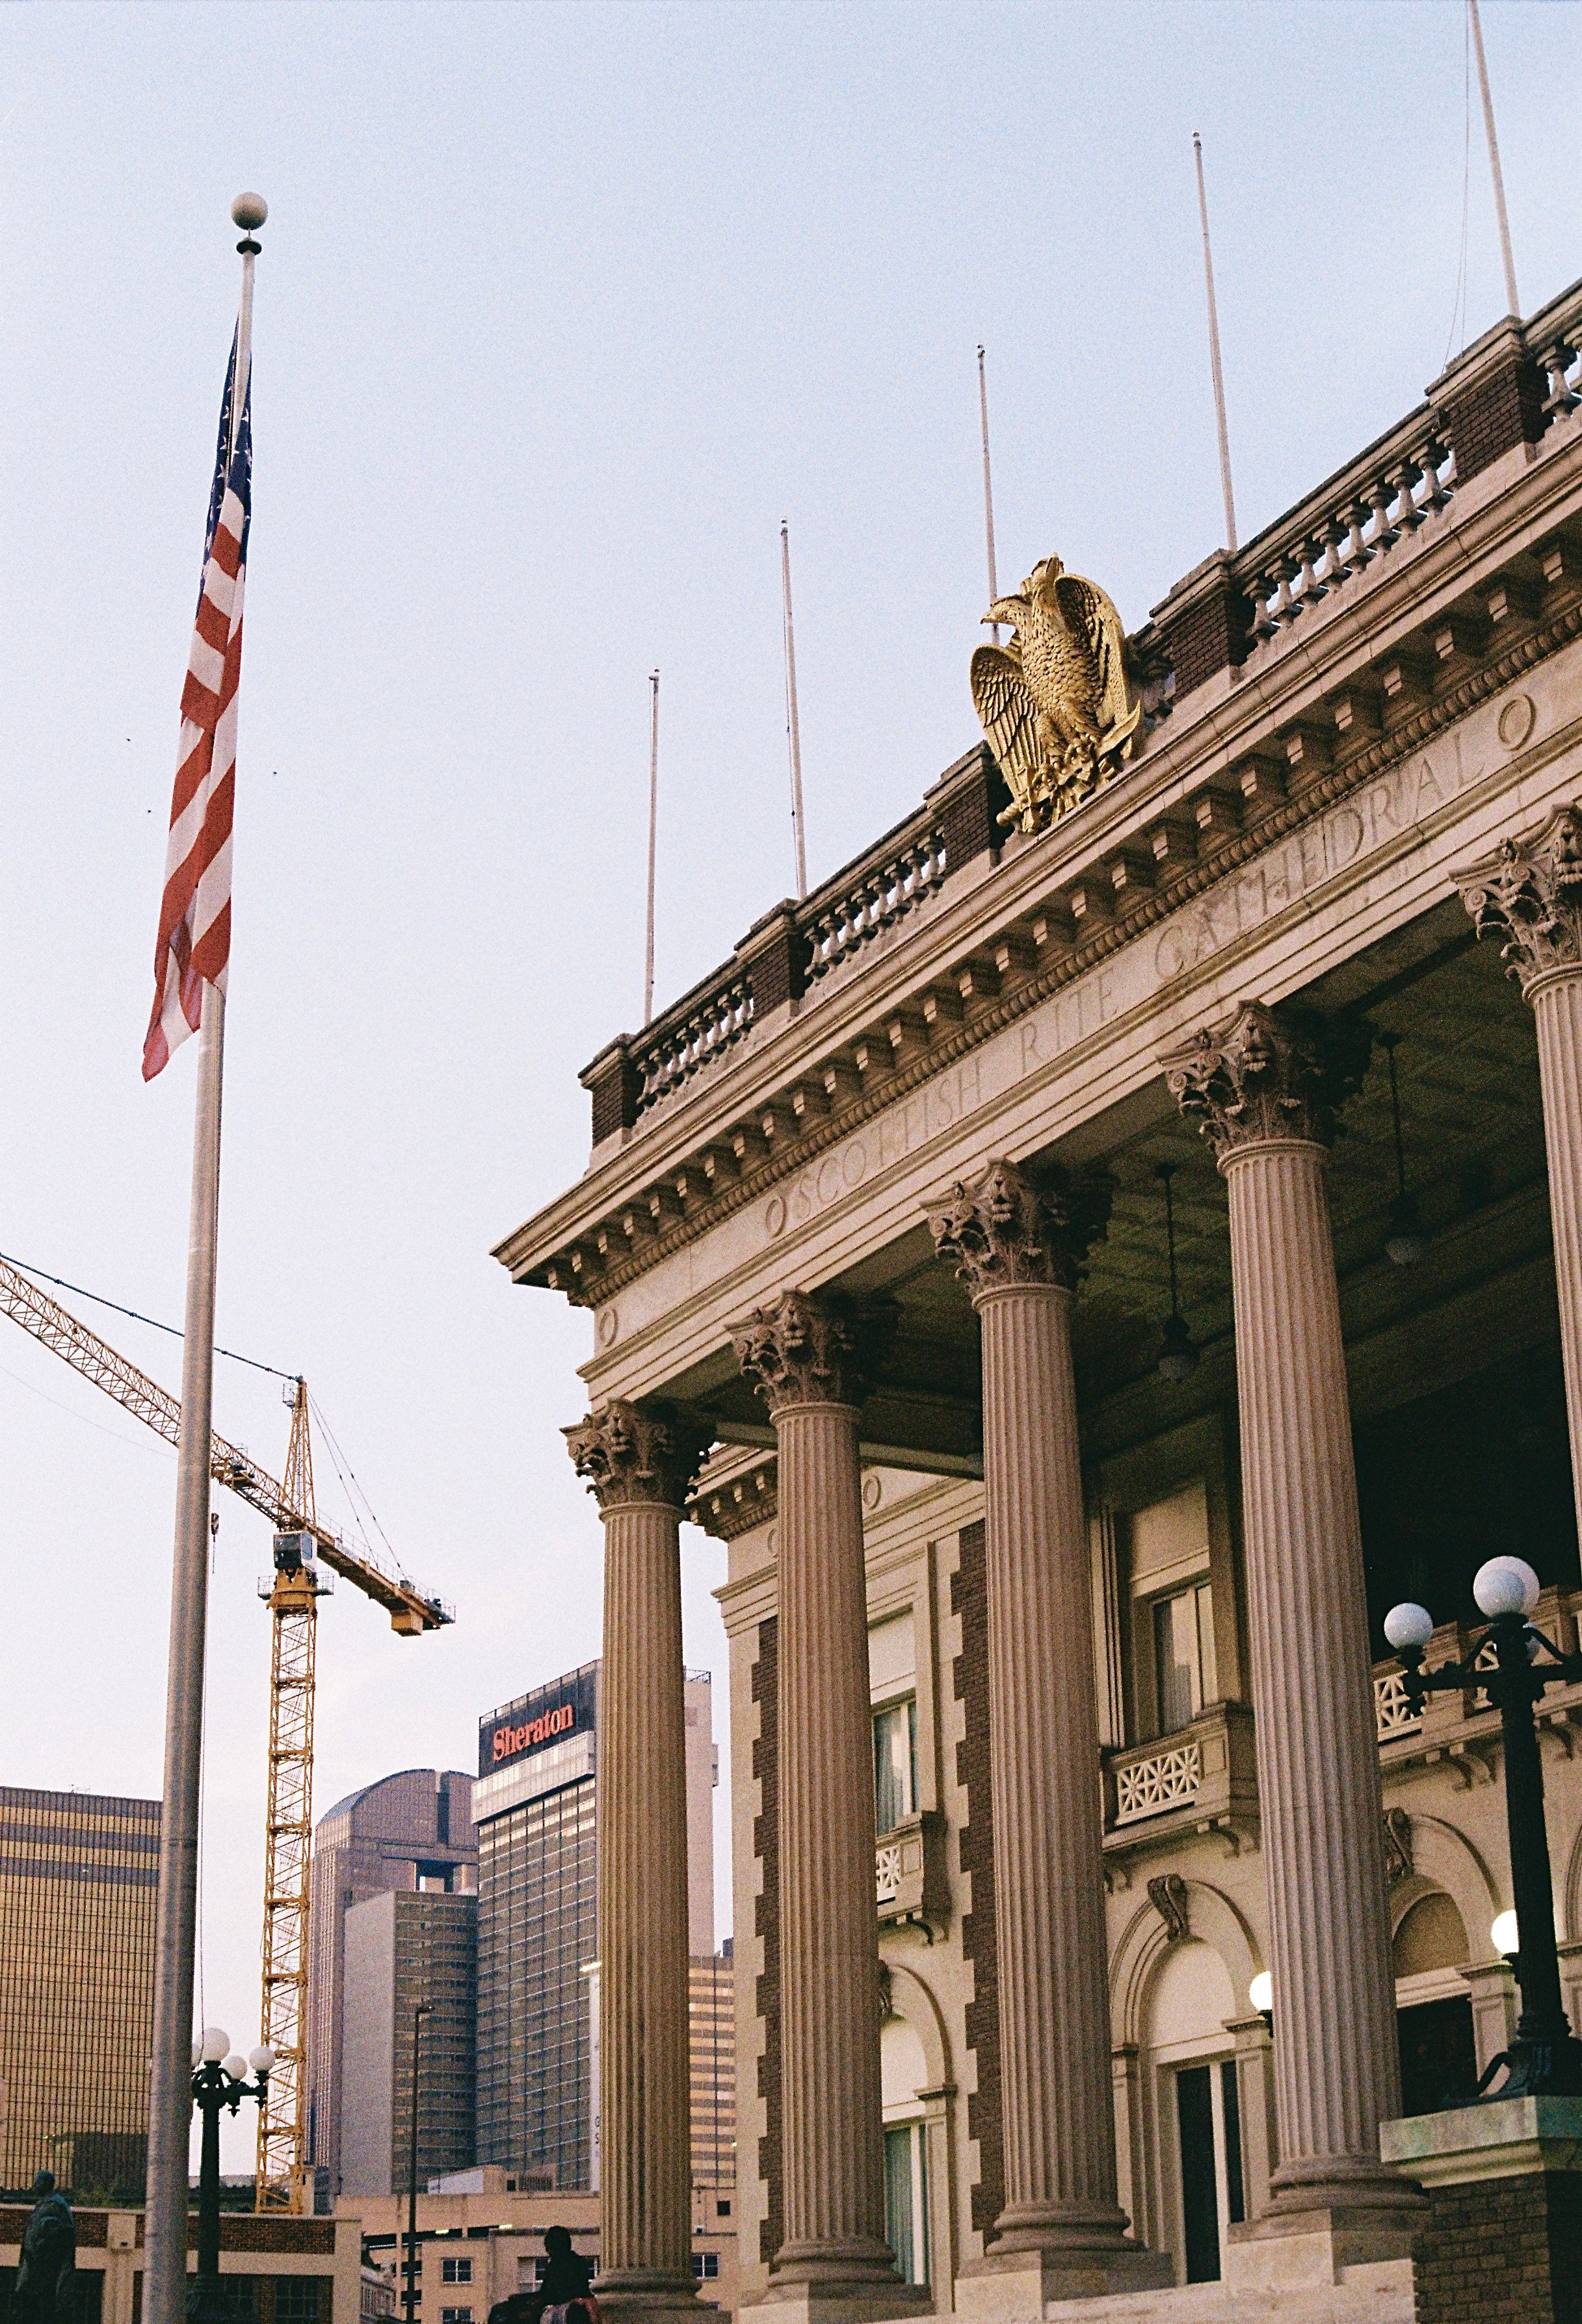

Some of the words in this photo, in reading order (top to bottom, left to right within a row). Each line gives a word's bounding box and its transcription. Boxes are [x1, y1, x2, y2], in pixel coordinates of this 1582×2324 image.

[792, 1055, 982, 1220] SCOTTISH
[1020, 966, 1118, 1075] RITE
[1155, 732, 1486, 976] CATHEDRAL
[493, 1704, 573, 1761] Sheraton
